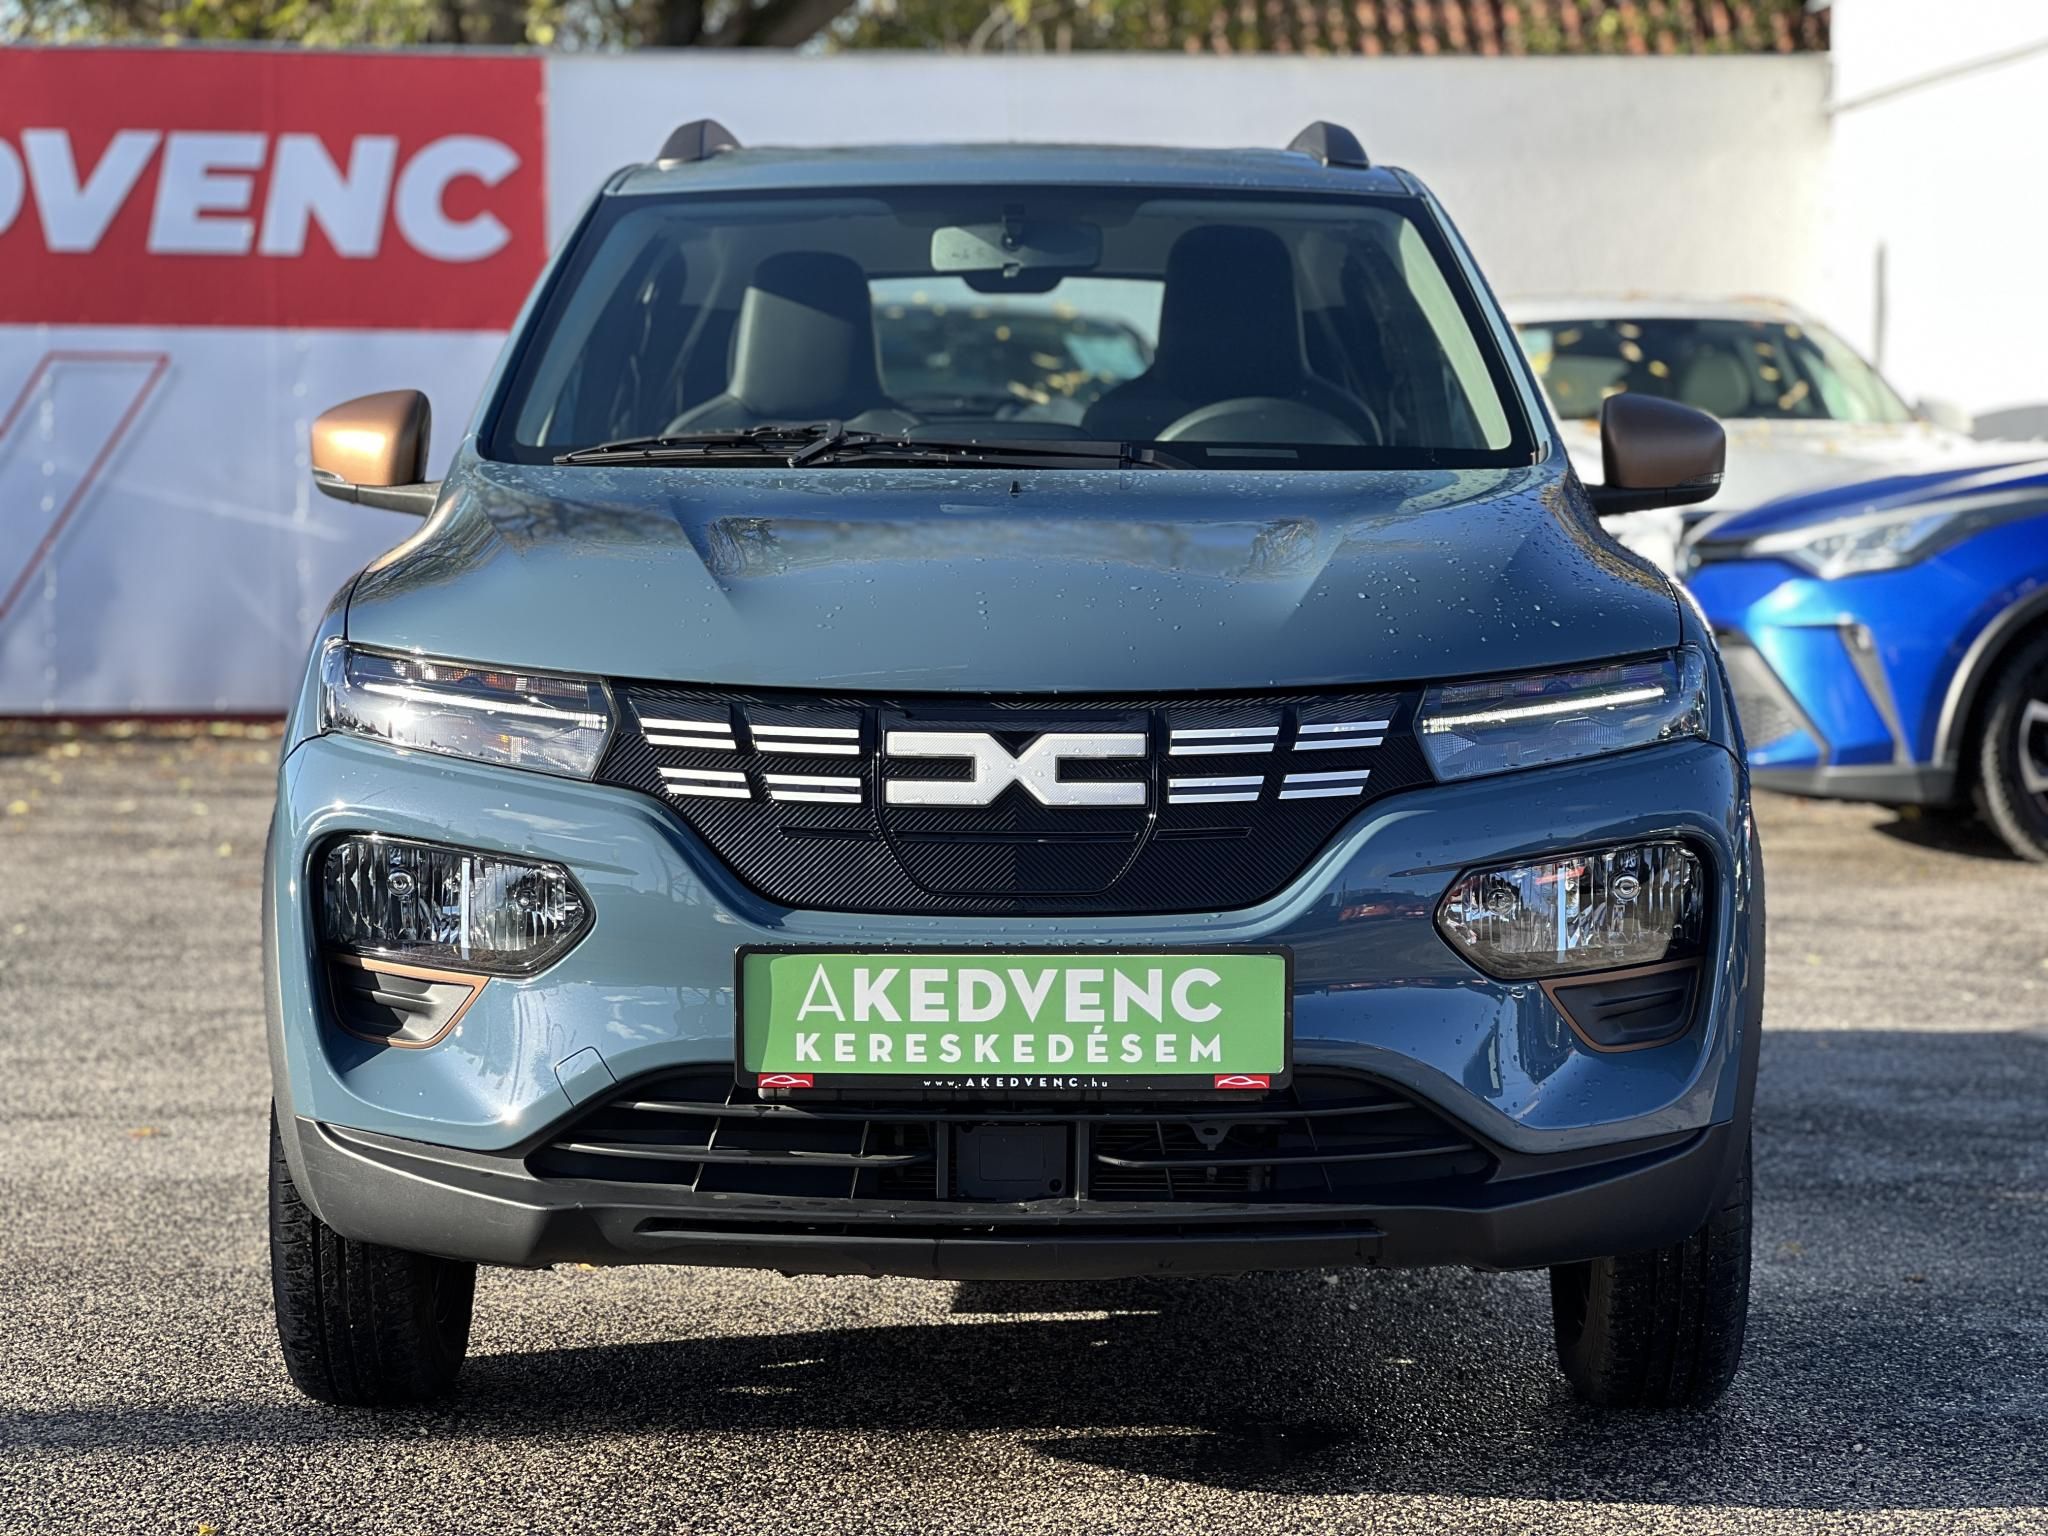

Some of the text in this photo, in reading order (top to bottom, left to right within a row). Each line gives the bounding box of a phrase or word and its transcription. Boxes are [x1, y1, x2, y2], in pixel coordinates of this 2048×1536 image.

[0, 127, 520, 263] VENC
[795, 1025, 1222, 1063] KERESKEDÉSEM
[923, 1077, 1108, 1089] www.AKEDVENC.hu
